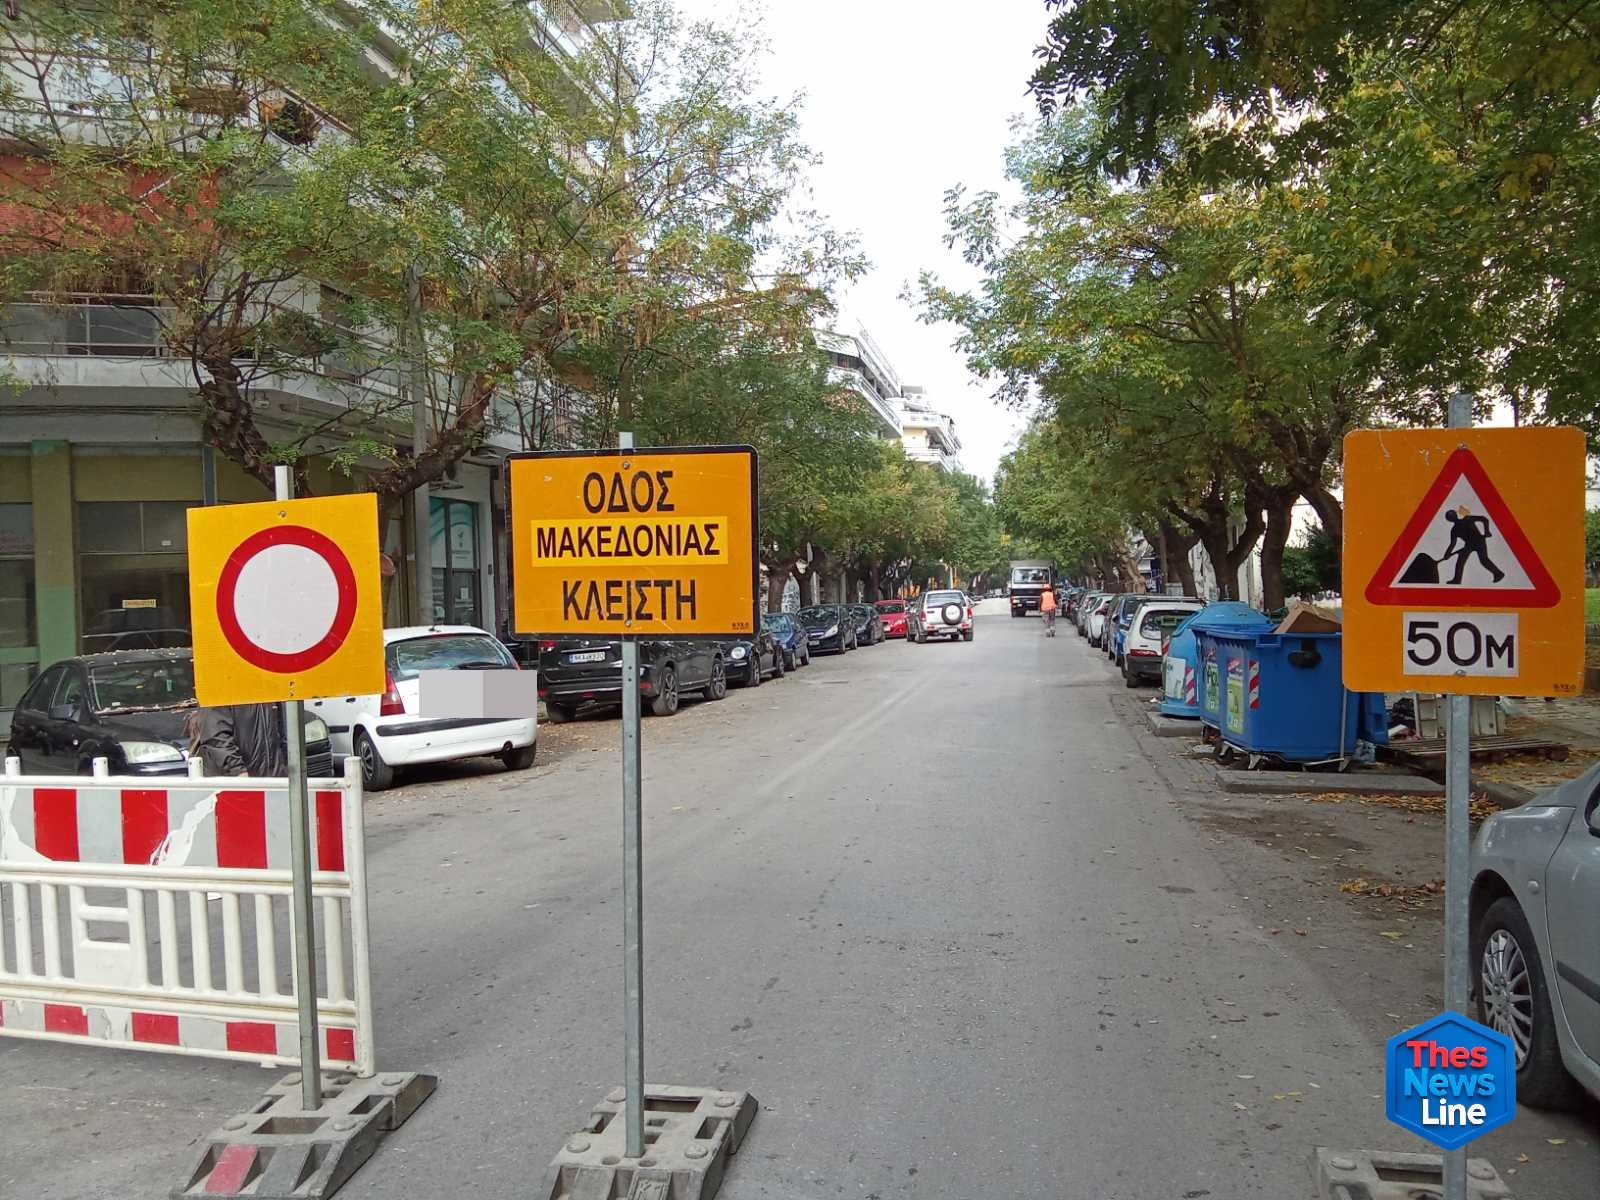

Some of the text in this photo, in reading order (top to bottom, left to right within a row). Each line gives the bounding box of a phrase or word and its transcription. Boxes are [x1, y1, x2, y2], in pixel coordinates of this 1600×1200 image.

[583, 470, 675, 514] ΟΔΟΣ
[537, 523, 720, 558] ΜΑΚΕΔΟΝΙΑΣ
[562, 579, 697, 621] ΚΛΕΙΣΤΗ
